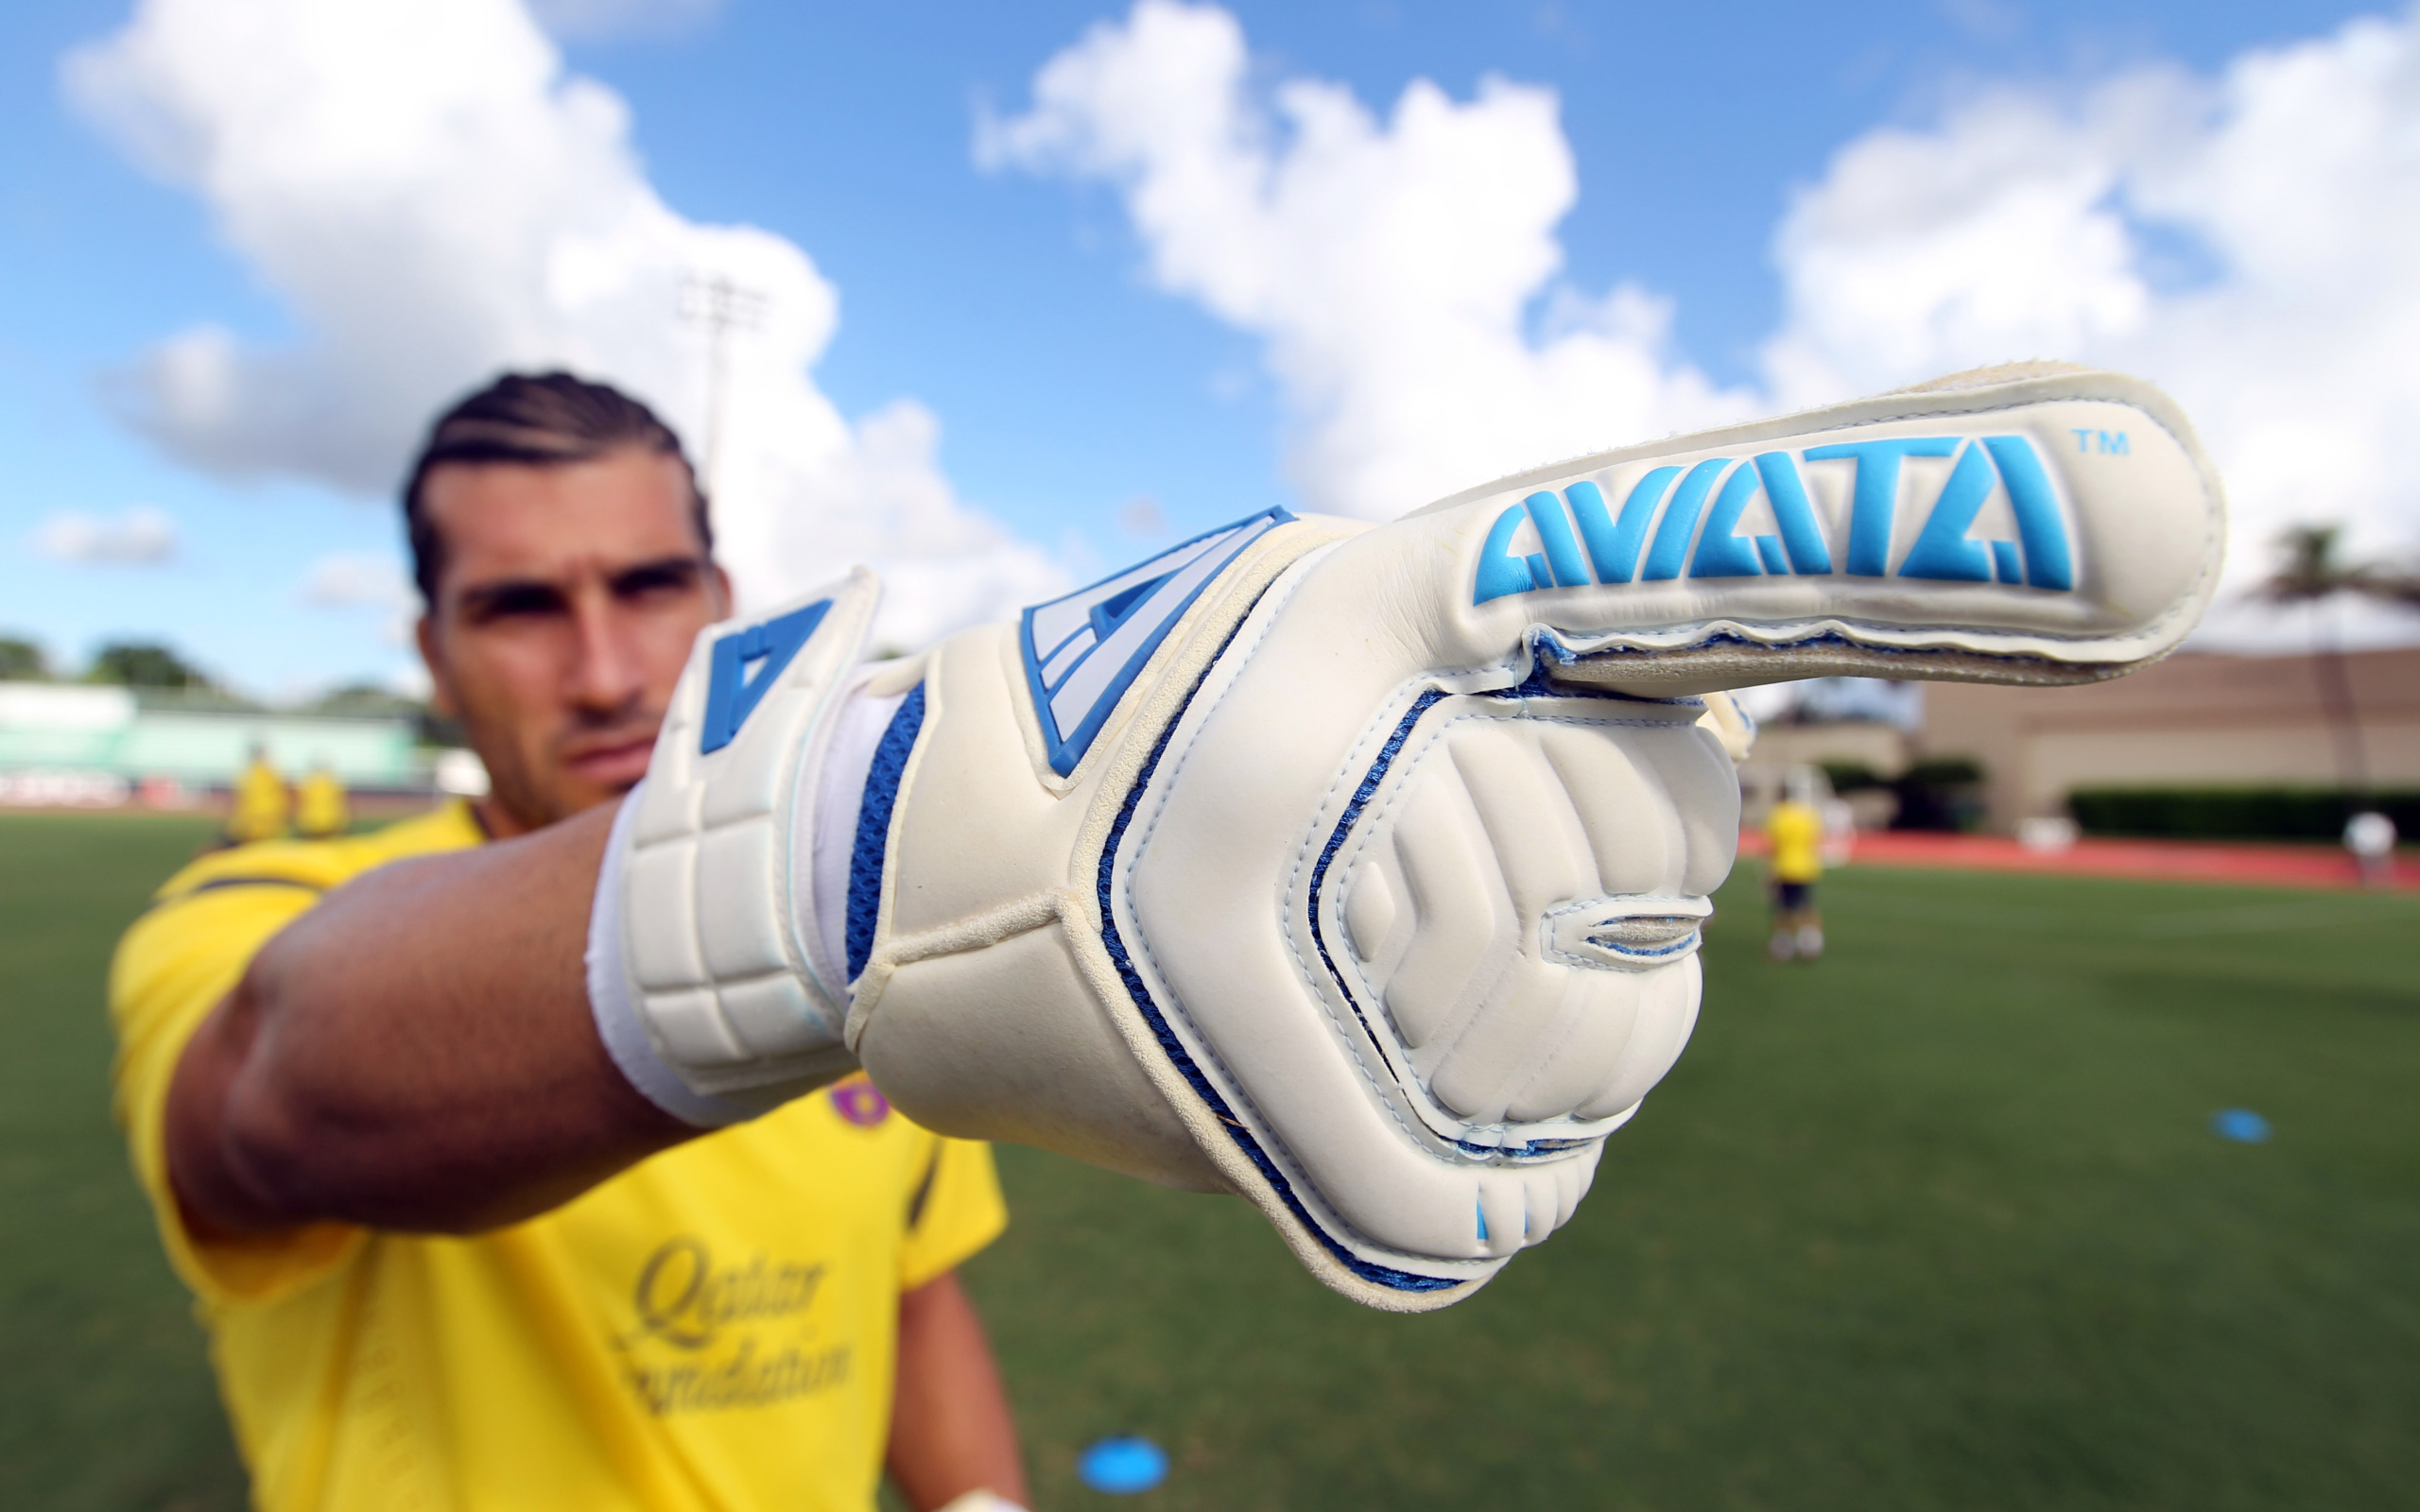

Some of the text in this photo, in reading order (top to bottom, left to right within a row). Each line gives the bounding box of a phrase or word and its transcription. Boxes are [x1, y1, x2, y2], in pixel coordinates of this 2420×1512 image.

[1473, 428, 2131, 607] AVIATA TM
[635, 1235, 830, 1349] Qatar
